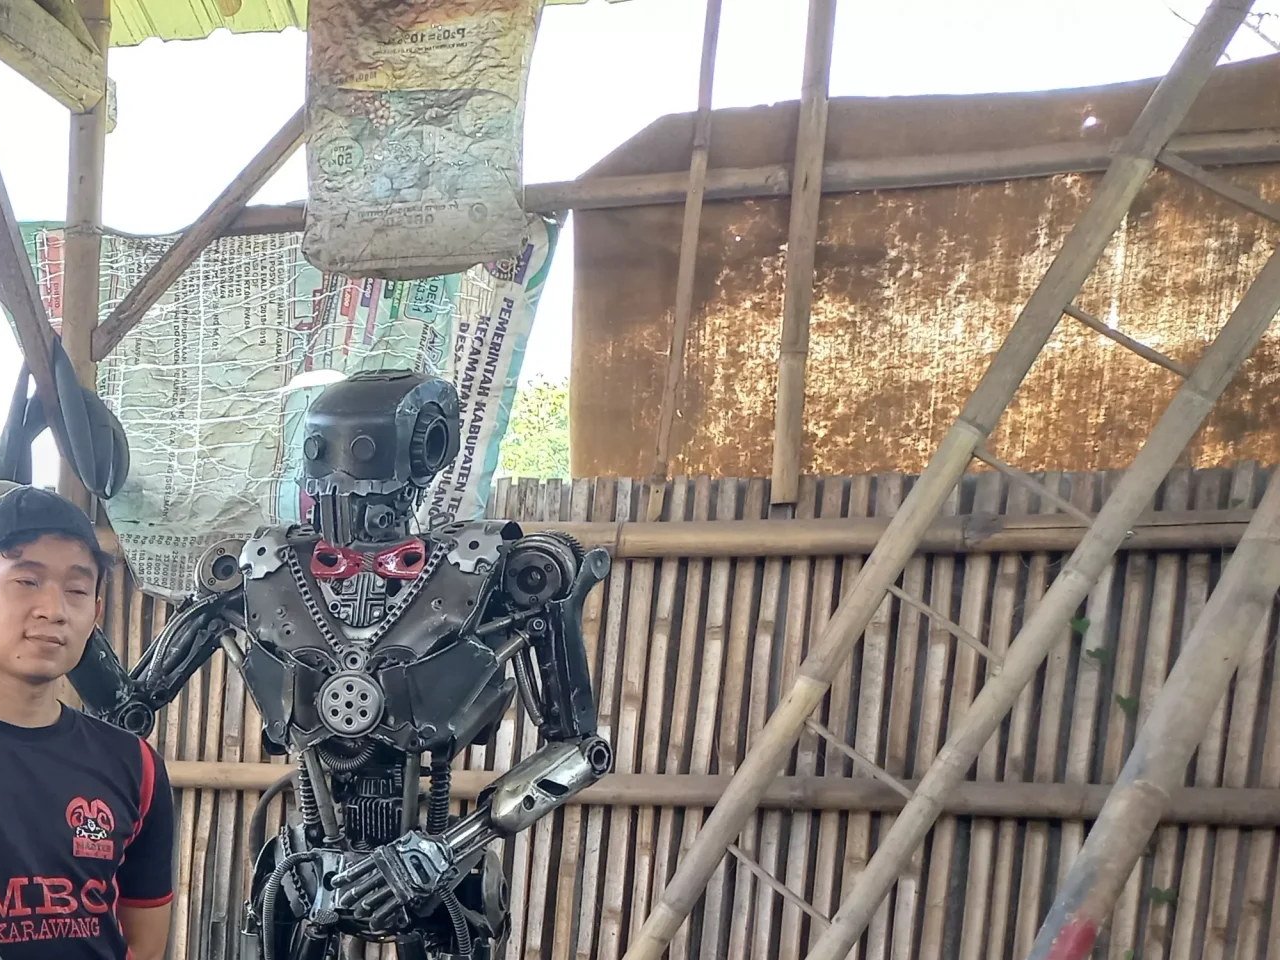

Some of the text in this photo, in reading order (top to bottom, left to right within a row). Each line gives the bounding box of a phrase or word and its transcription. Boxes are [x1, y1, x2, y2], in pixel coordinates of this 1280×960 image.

[458, 315, 491, 414] KECAMATAN
[477, 297, 514, 398] PEMERINTAH
[454, 400, 486, 492] KABUPATEN
